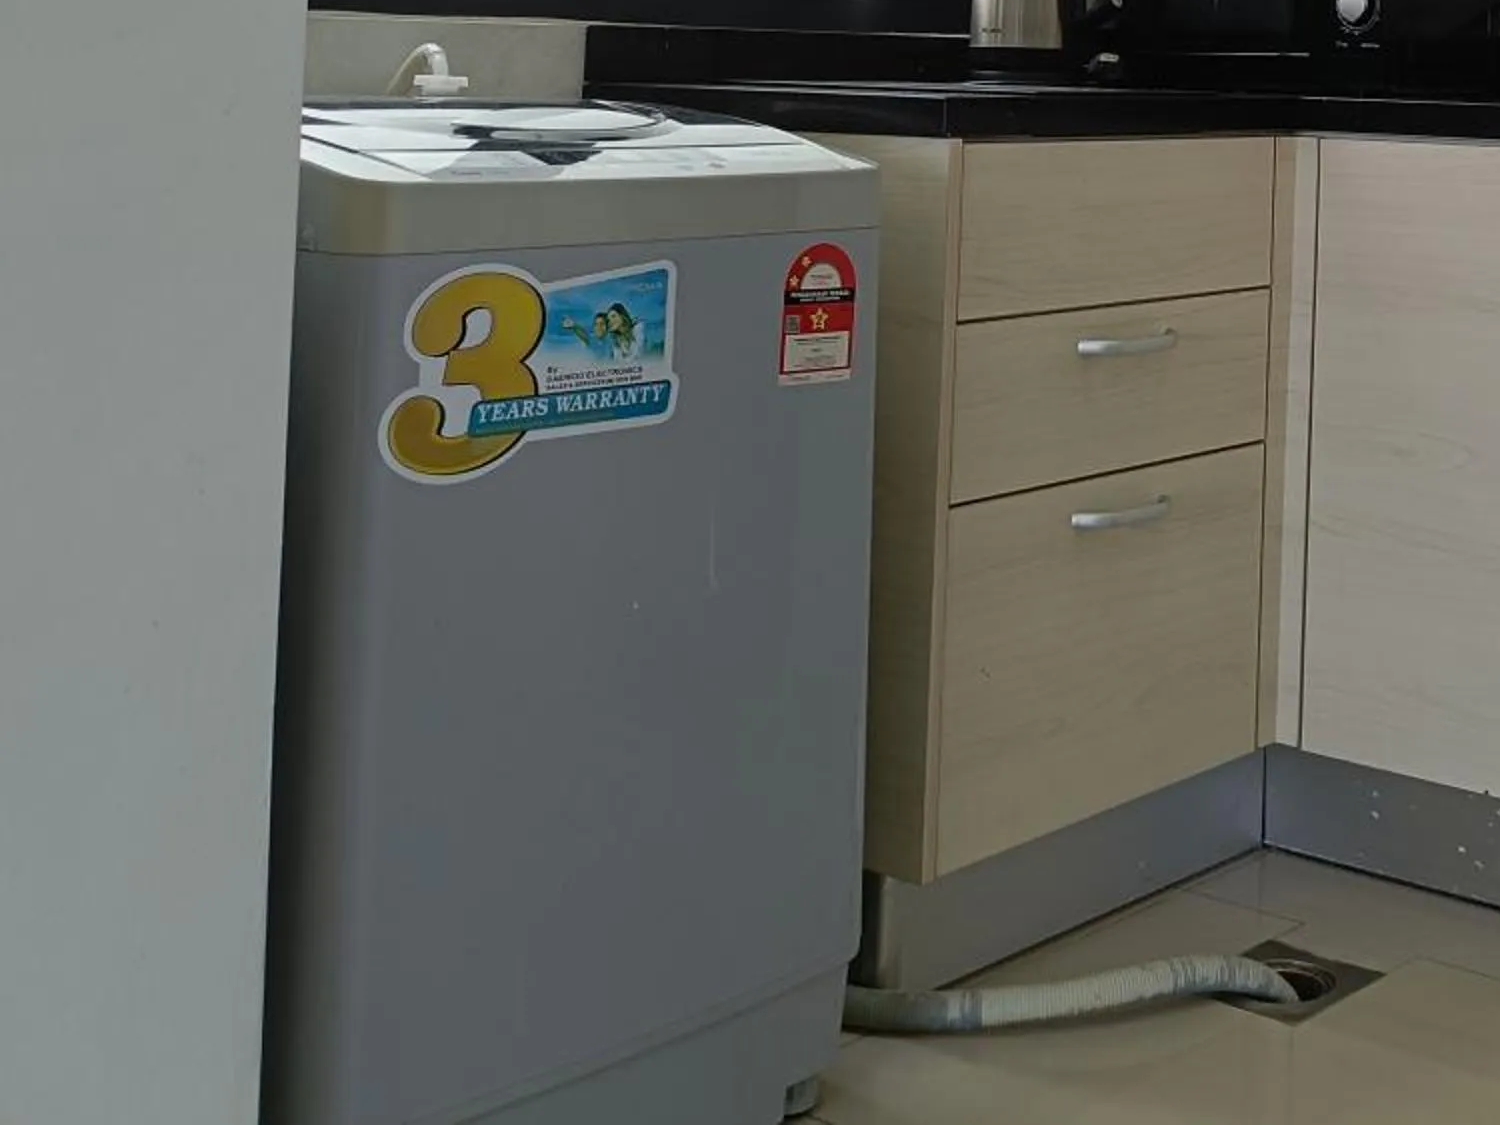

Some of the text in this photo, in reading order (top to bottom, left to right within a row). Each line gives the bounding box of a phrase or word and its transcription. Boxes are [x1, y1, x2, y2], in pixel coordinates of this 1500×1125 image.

[388, 272, 546, 476] 3
[478, 383, 666, 424] YEARS WARRANTY
